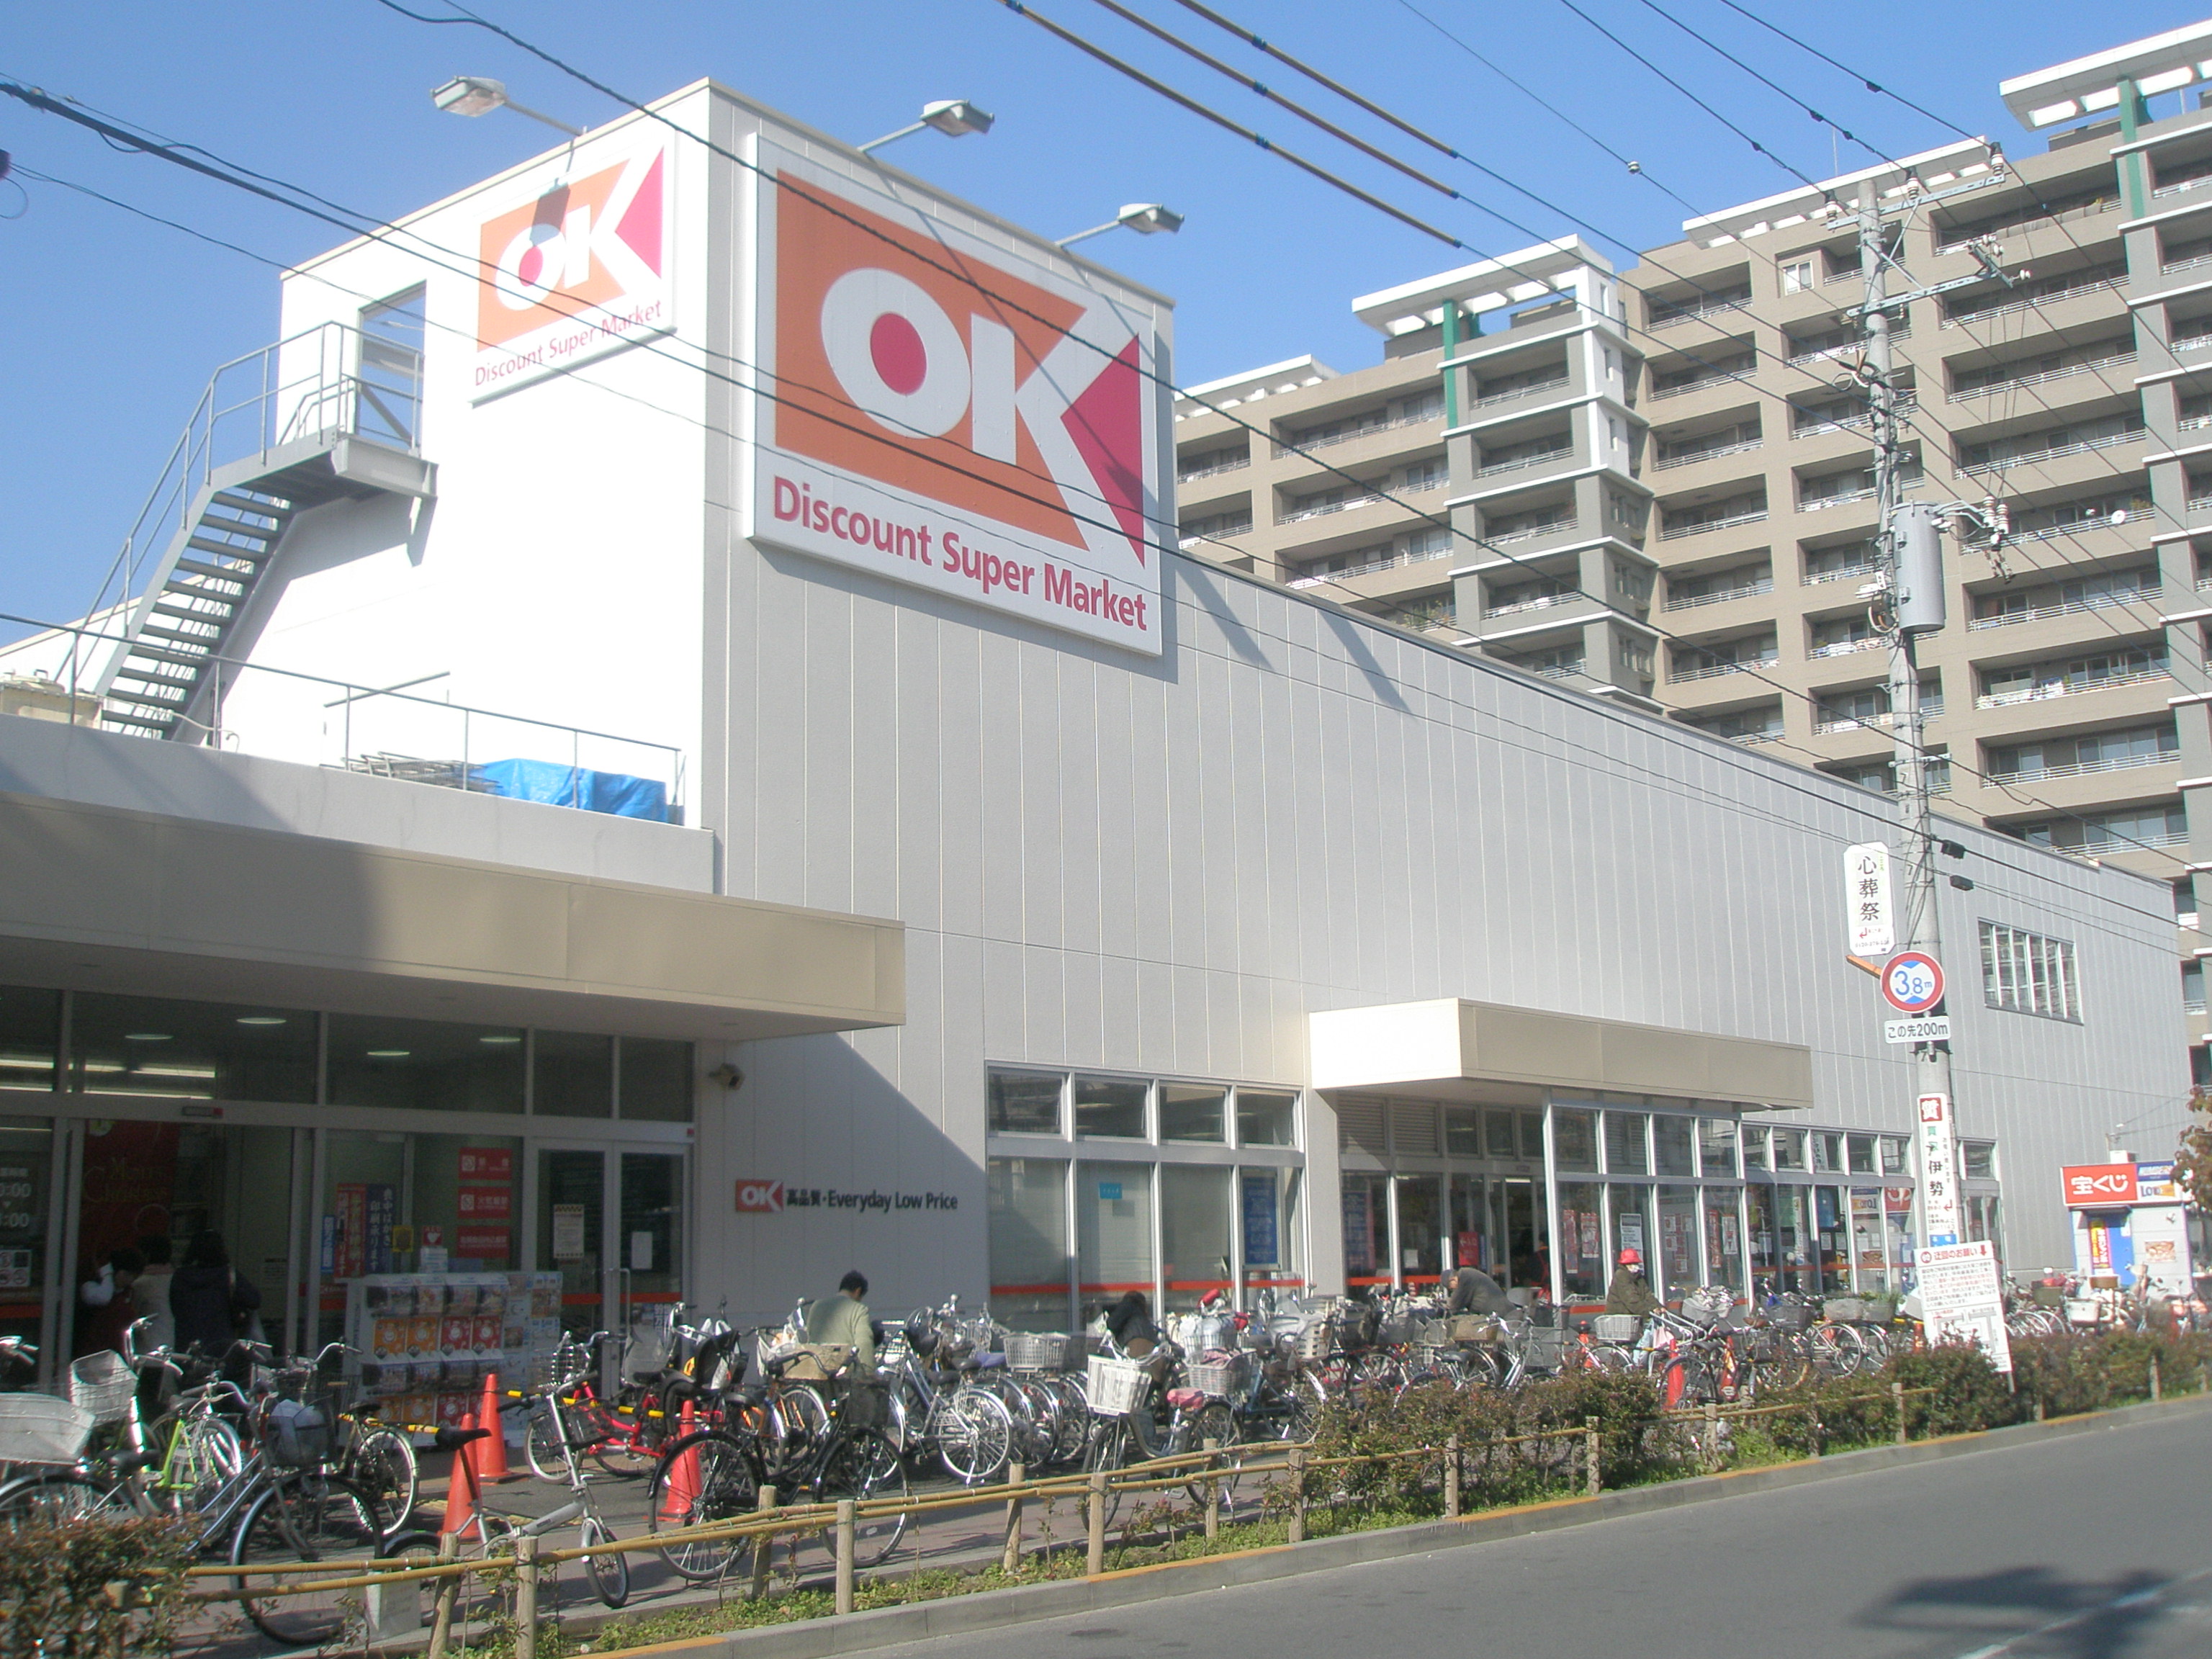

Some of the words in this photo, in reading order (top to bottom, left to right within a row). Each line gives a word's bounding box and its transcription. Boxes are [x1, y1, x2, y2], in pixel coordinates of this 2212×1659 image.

[495, 148, 664, 311] OK
[474, 345, 544, 387] Discount
[548, 320, 597, 359] Super
[601, 300, 662, 335] Market
[820, 267, 1145, 570] OK
[773, 474, 933, 567] Discount
[942, 531, 1035, 595] Super
[1043, 566, 1147, 632] Market
[1858, 856, 1880, 921] 心葬祭
[1888, 1022, 1948, 1038] この先200m
[1921, 1099, 1940, 1120] 質
[740, 1179, 783, 1212] OK
[828, 1190, 892, 1213] Everyday
[895, 1191, 922, 1210] Low
[926, 1191, 958, 1210] Price
[2071, 1174, 2128, 1195] 宝くじ
